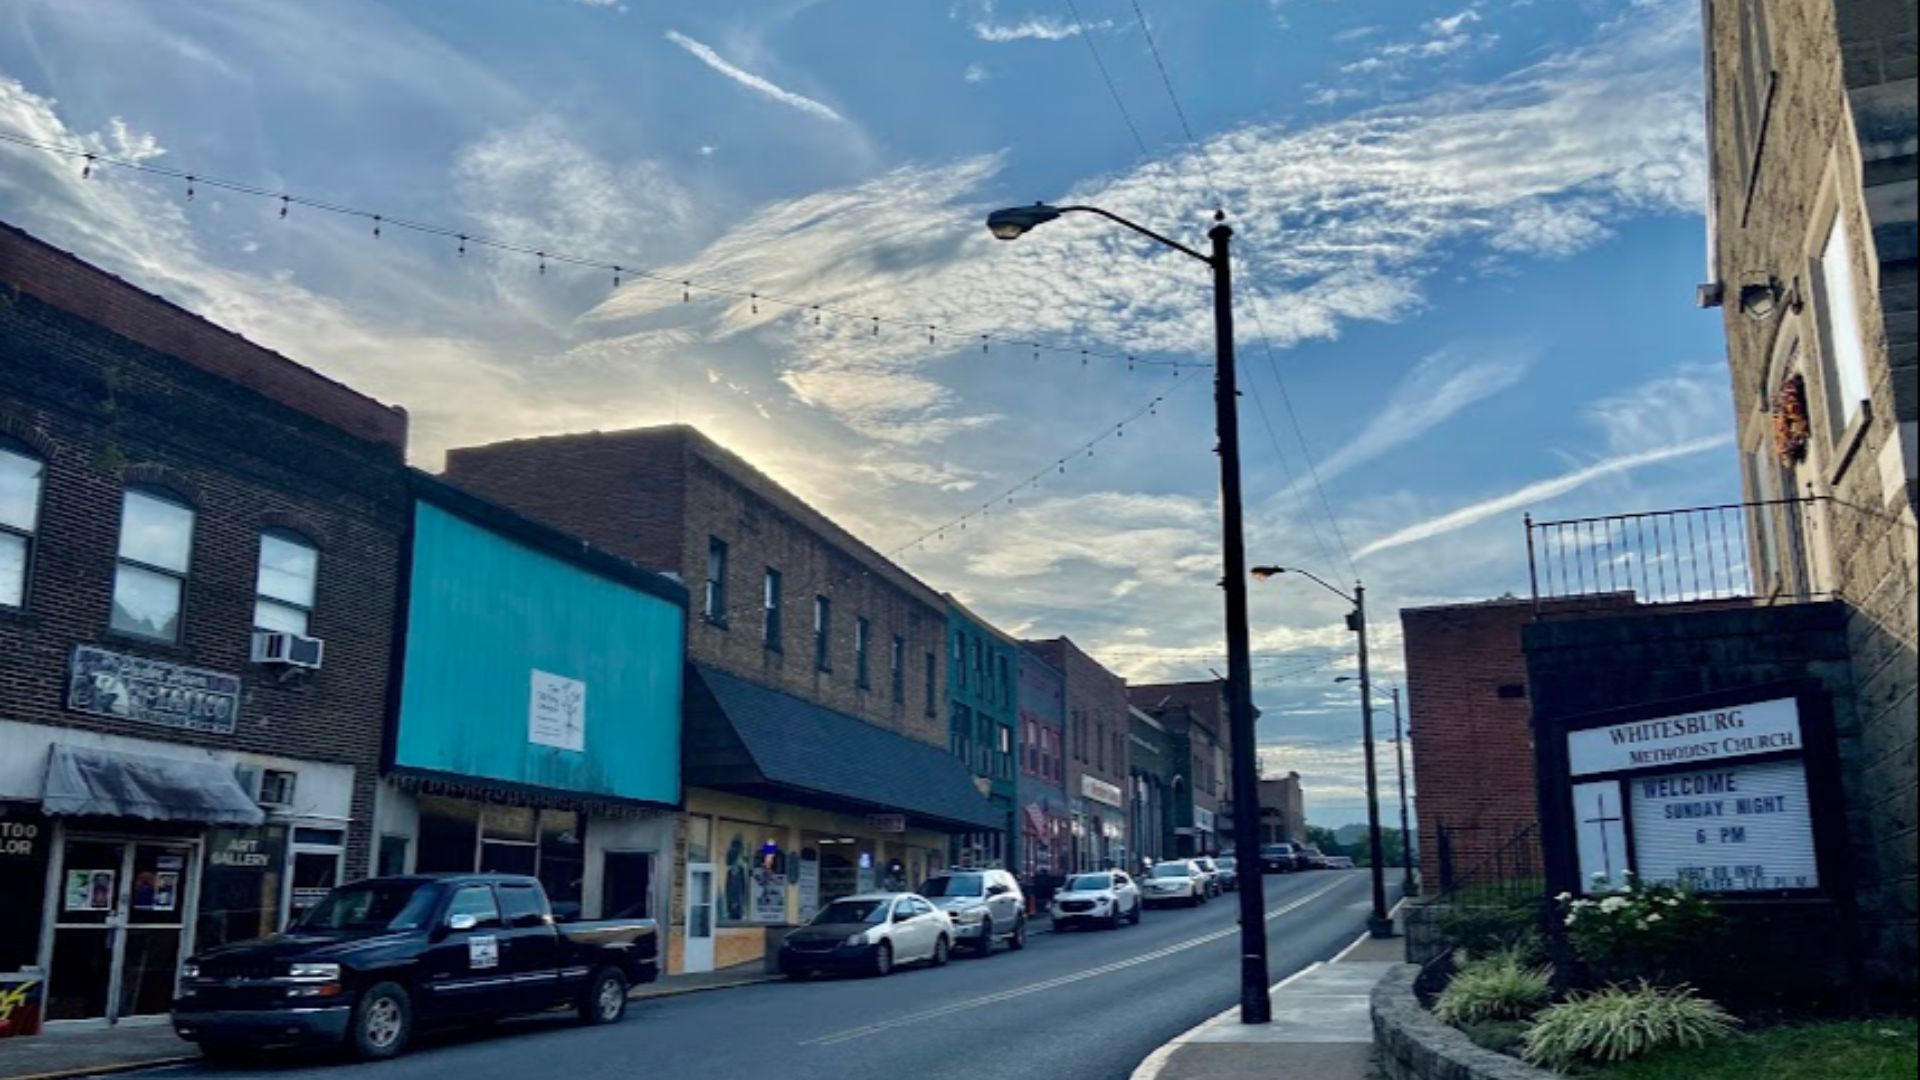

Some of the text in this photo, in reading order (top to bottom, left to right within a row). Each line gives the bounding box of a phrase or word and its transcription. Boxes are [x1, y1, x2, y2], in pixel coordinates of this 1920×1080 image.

[1610, 711, 1744, 745] WHITESBURG
[1629, 732, 1794, 764] METHODIST CHURCH
[1642, 773, 1736, 798] WELCOME
[1664, 796, 1785, 819] SUNDAY NIGHT
[226, 838, 259, 853] ART
[1696, 827, 1746, 844] 6 PM
[210, 852, 271, 866] GALLERY
